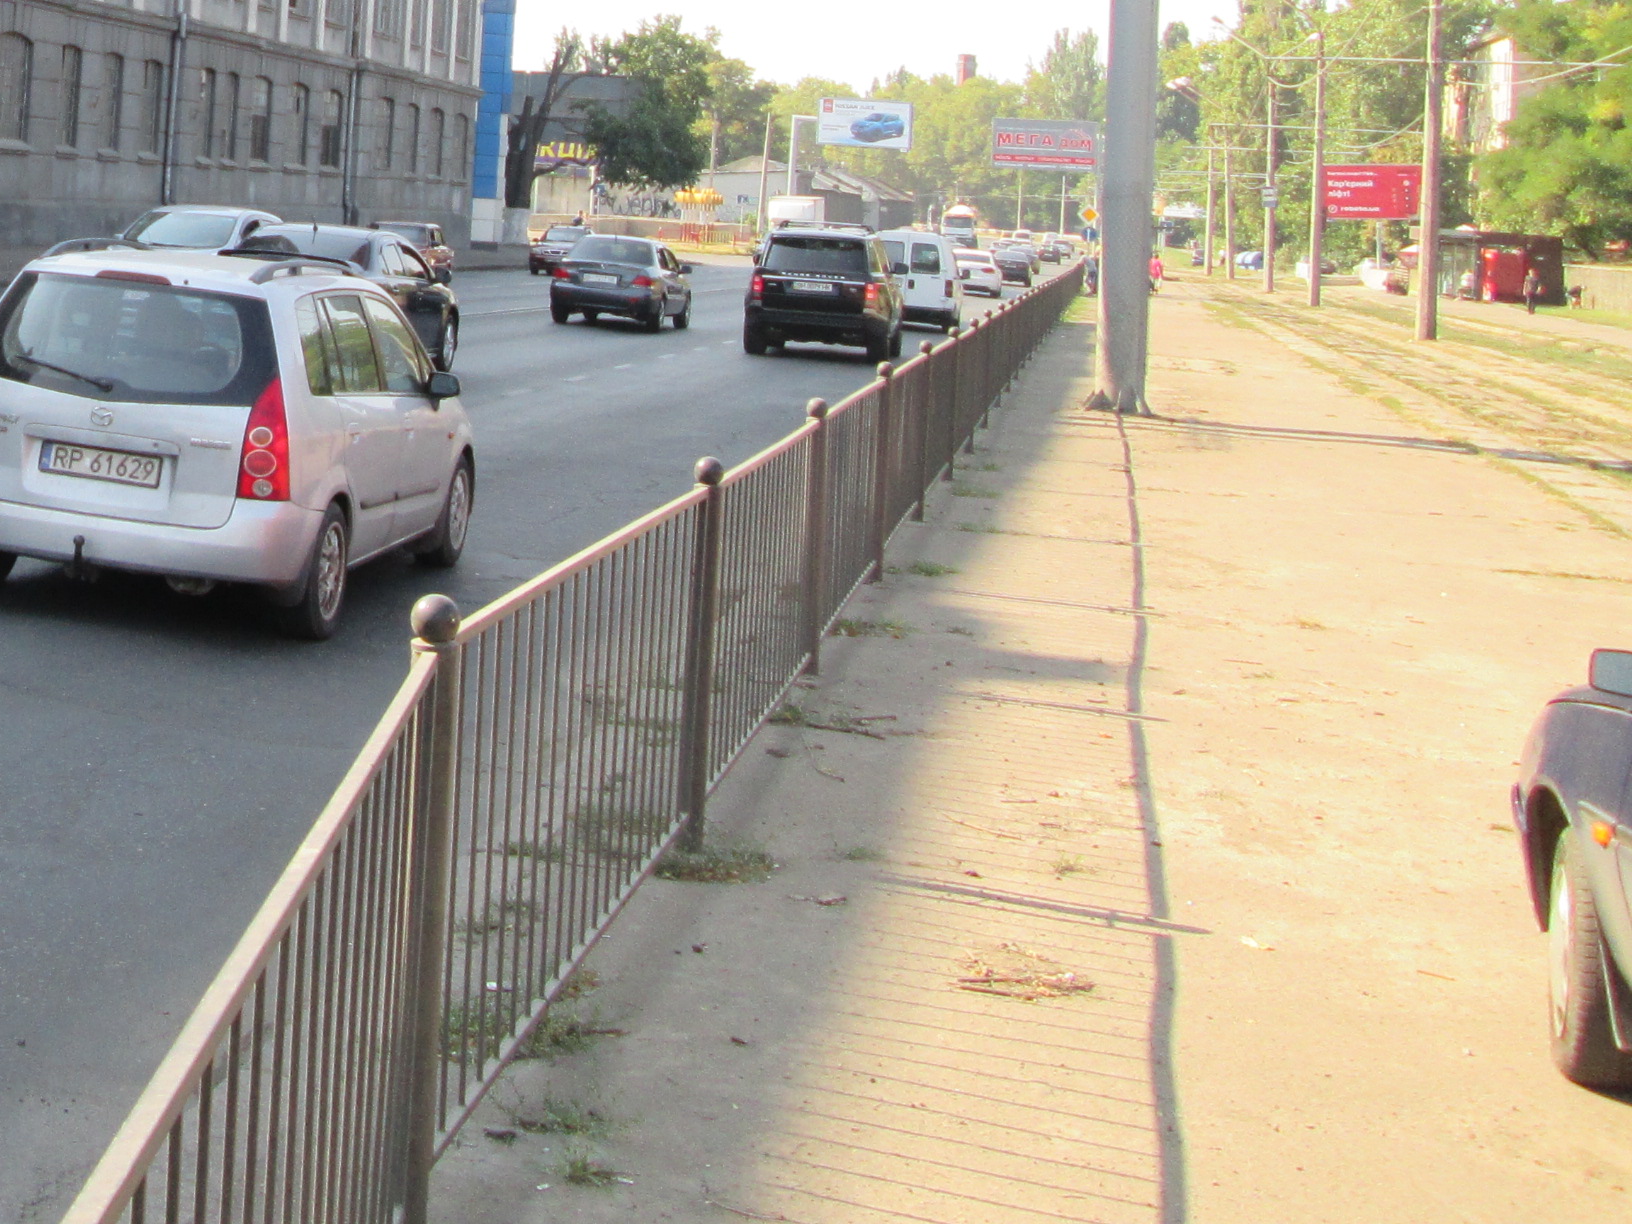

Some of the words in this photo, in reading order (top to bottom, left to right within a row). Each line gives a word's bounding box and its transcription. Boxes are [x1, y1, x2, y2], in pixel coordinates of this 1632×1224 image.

[997, 131, 1054, 149] МЕГА
[53, 446, 83, 470] RP
[90, 454, 156, 481] 61629
